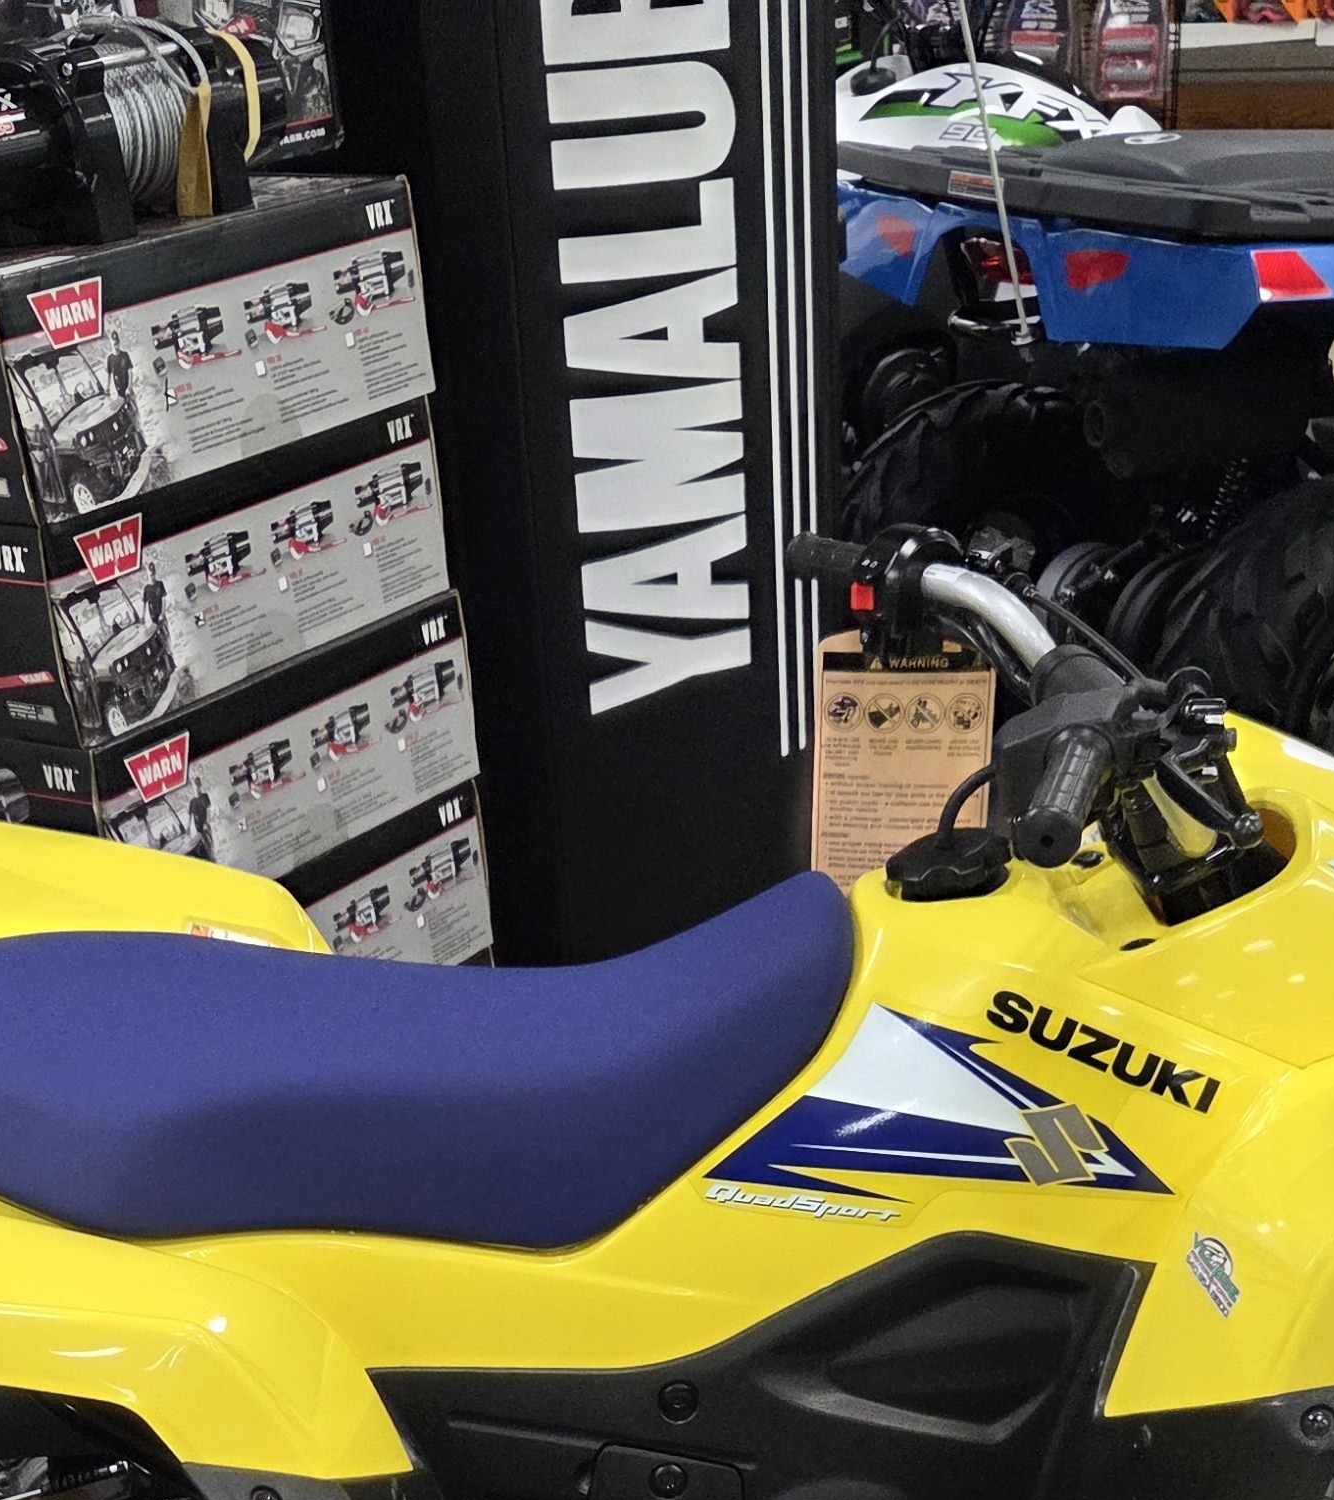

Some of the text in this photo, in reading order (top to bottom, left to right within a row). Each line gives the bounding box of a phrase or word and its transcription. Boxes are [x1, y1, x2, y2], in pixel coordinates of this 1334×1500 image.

[279, 127, 326, 147] ARN.COM
[365, 200, 394, 231] VRX
[43, 297, 97, 331] WARN
[386, 415, 414, 445] VRX
[87, 533, 136, 568] WARN
[888, 657, 950, 669] WARNING
[42, 763, 76, 793] VRX
[137, 754, 183, 787] WARN
[985, 989, 1222, 1115] SUZUKI
